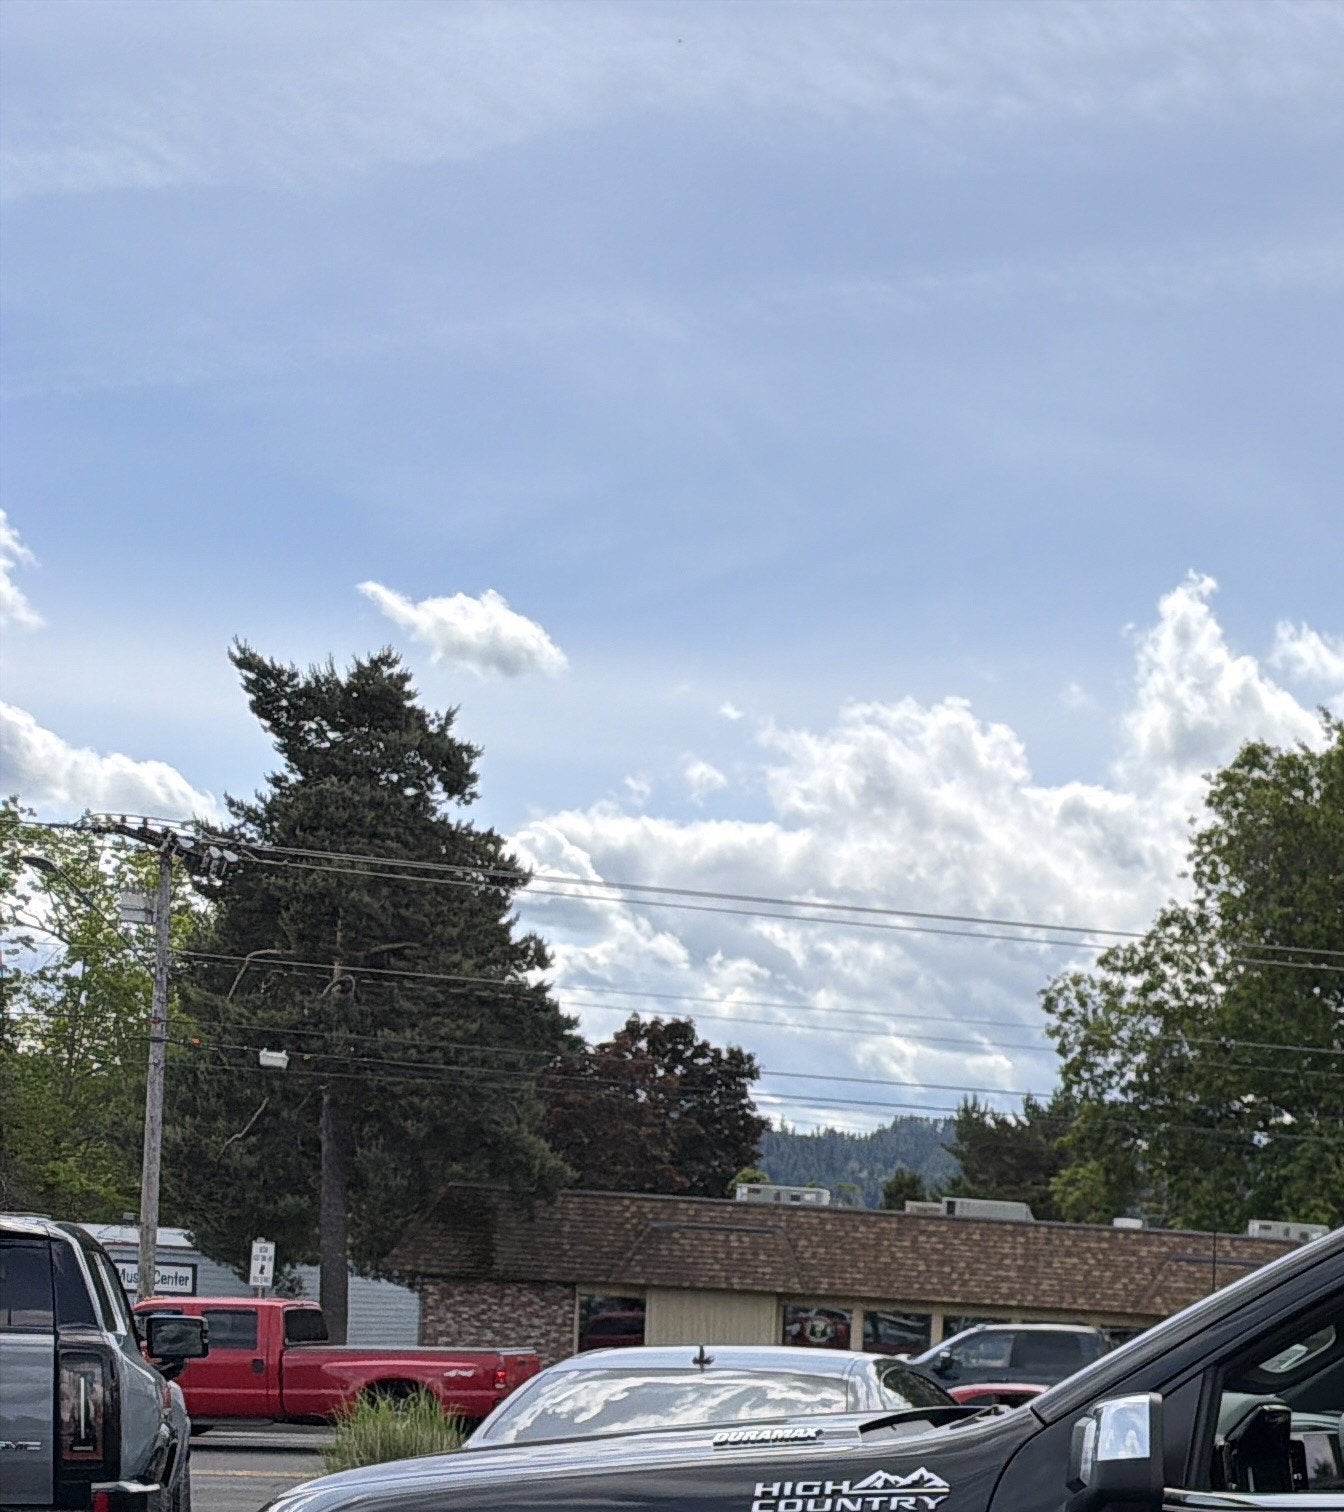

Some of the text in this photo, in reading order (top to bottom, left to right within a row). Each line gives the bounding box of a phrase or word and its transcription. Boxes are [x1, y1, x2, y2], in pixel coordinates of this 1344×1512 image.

[154, 1269, 190, 1287] Center
[713, 1427, 820, 1446] DURAMAX
[754, 1480, 852, 1498] HIGH
